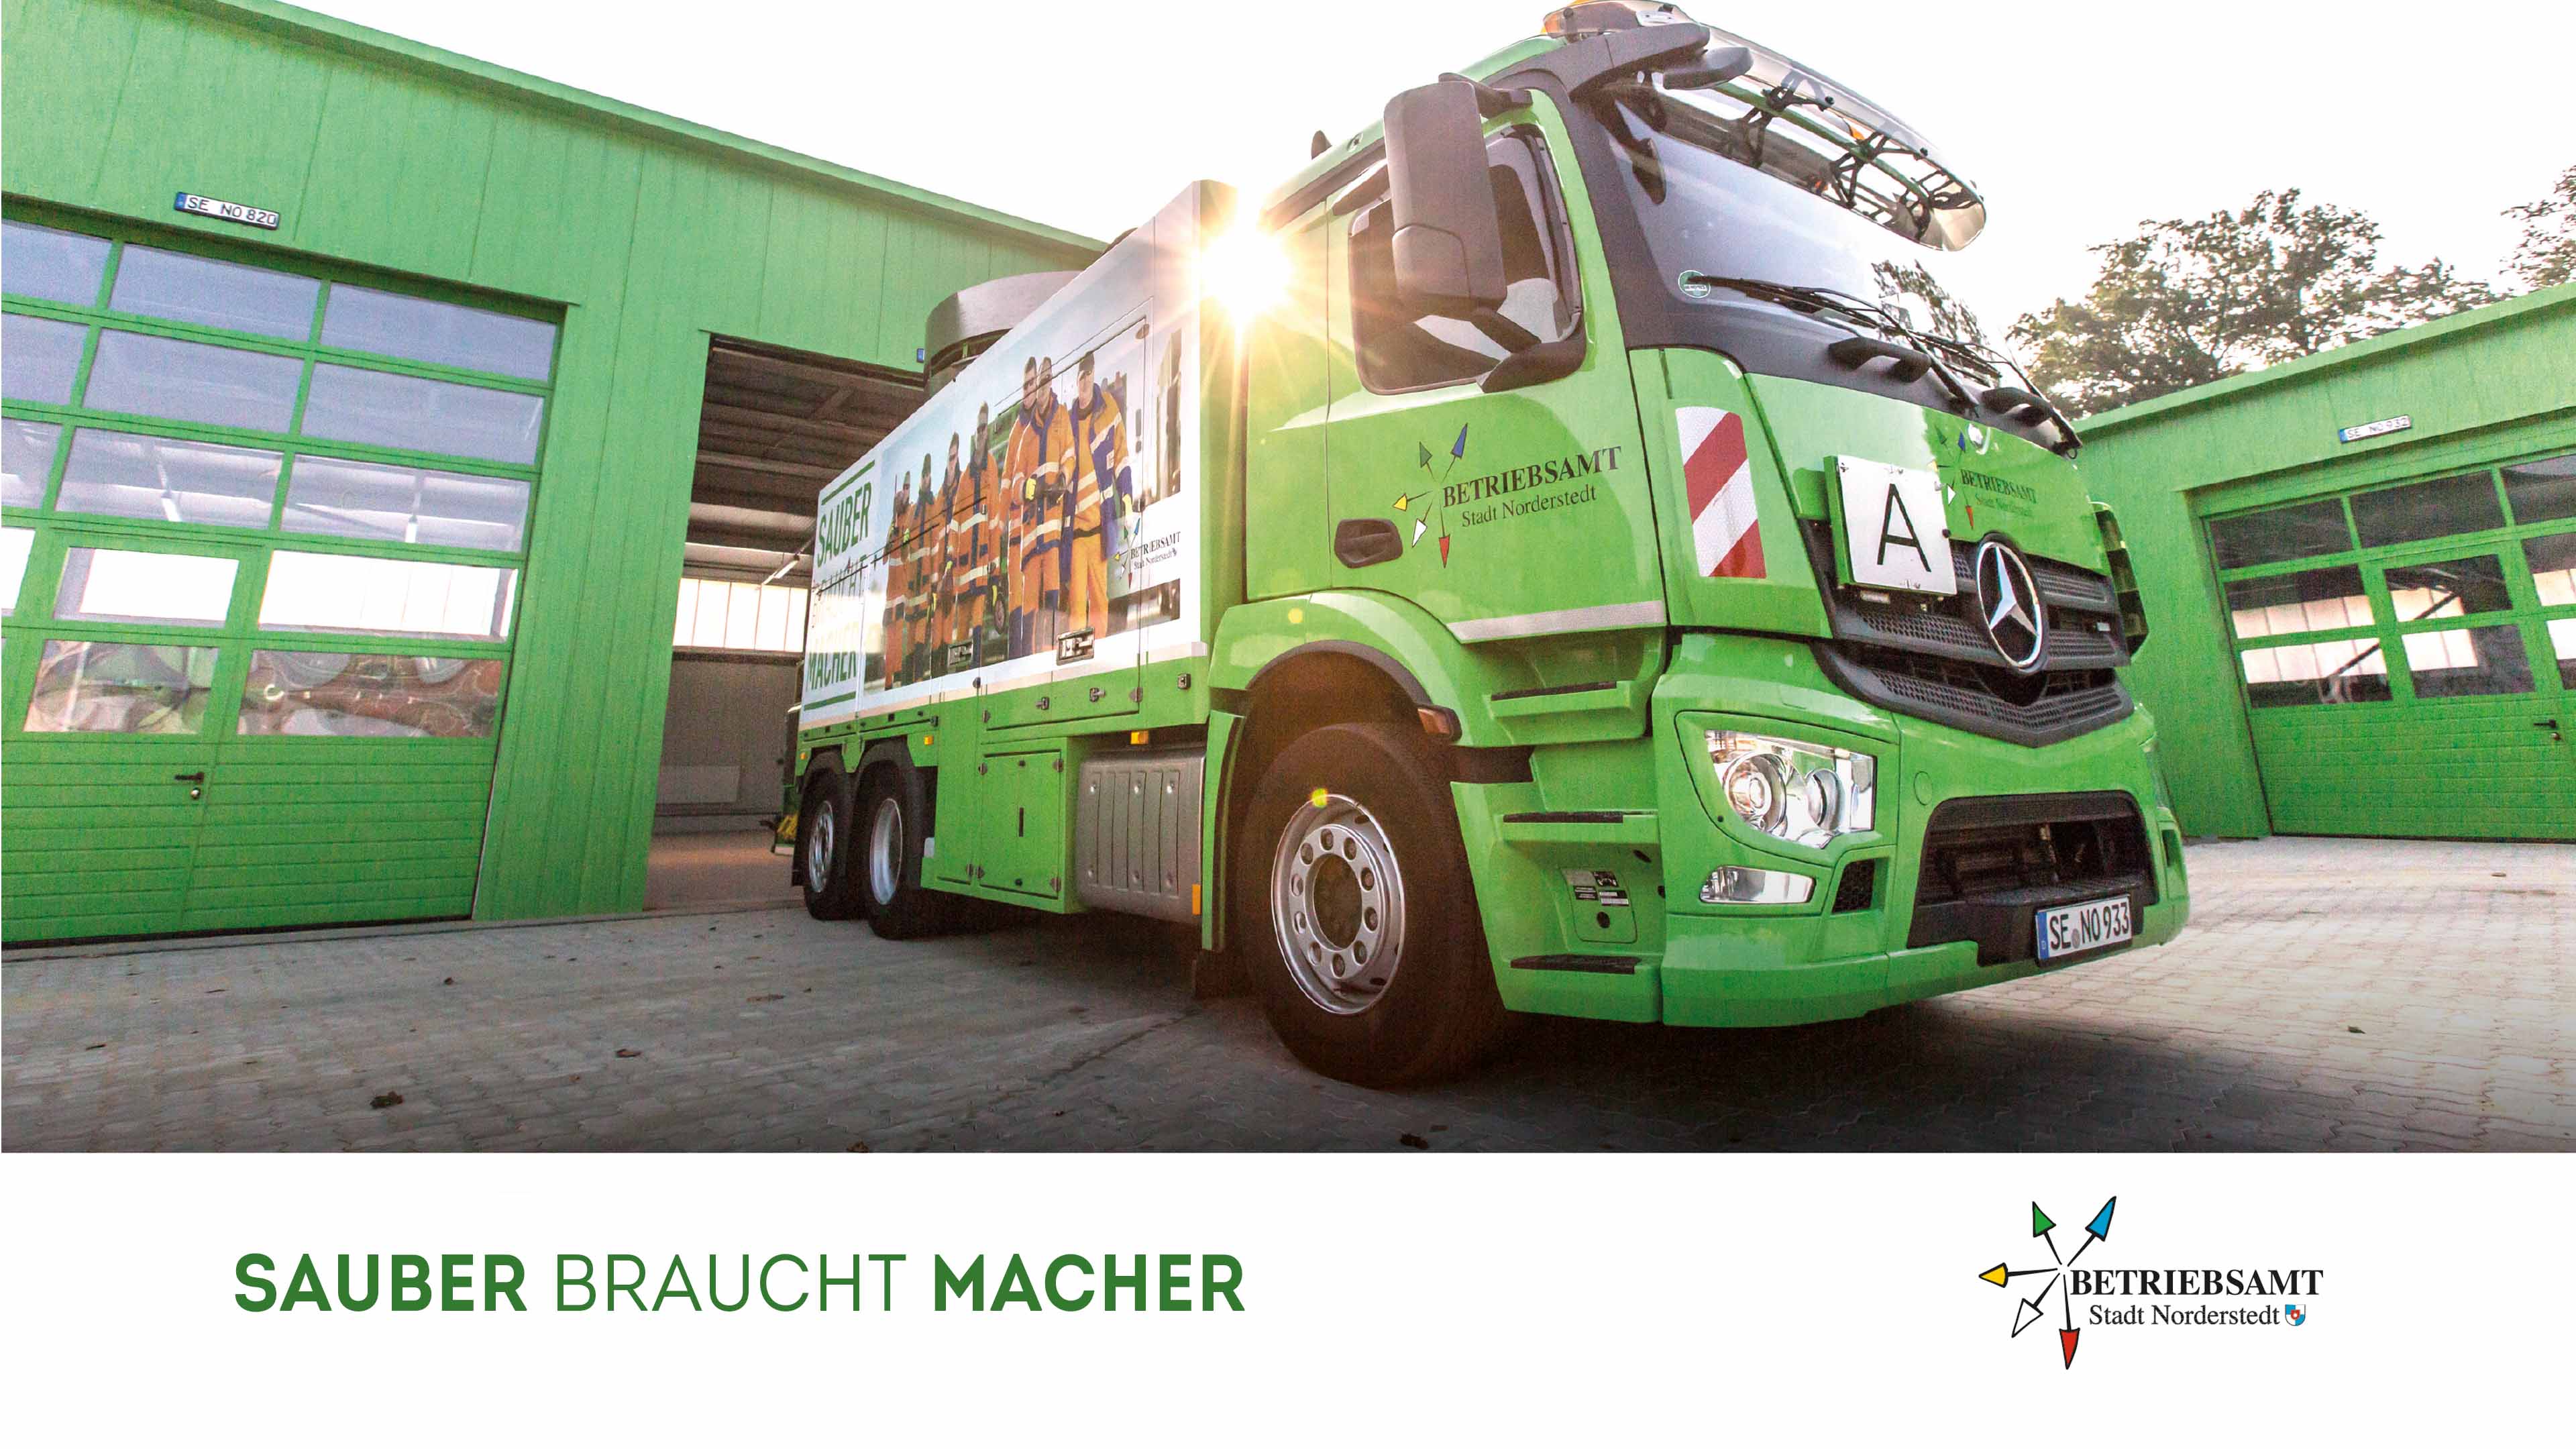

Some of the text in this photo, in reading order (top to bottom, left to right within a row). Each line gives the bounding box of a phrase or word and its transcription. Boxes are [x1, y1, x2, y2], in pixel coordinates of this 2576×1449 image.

[188, 197, 277, 225] SE NO 820
[1443, 445, 1621, 508] BETRIEBSAMT
[1961, 469, 2037, 504] BETRIEBSAMT
[817, 481, 872, 568] SAUBER
[1462, 484, 1597, 527] Stadt Norderstedt
[1877, 483, 1932, 572] A
[1130, 531, 1181, 559] BETRIEBSAMT
[2049, 902, 2129, 950] SE NO 933
